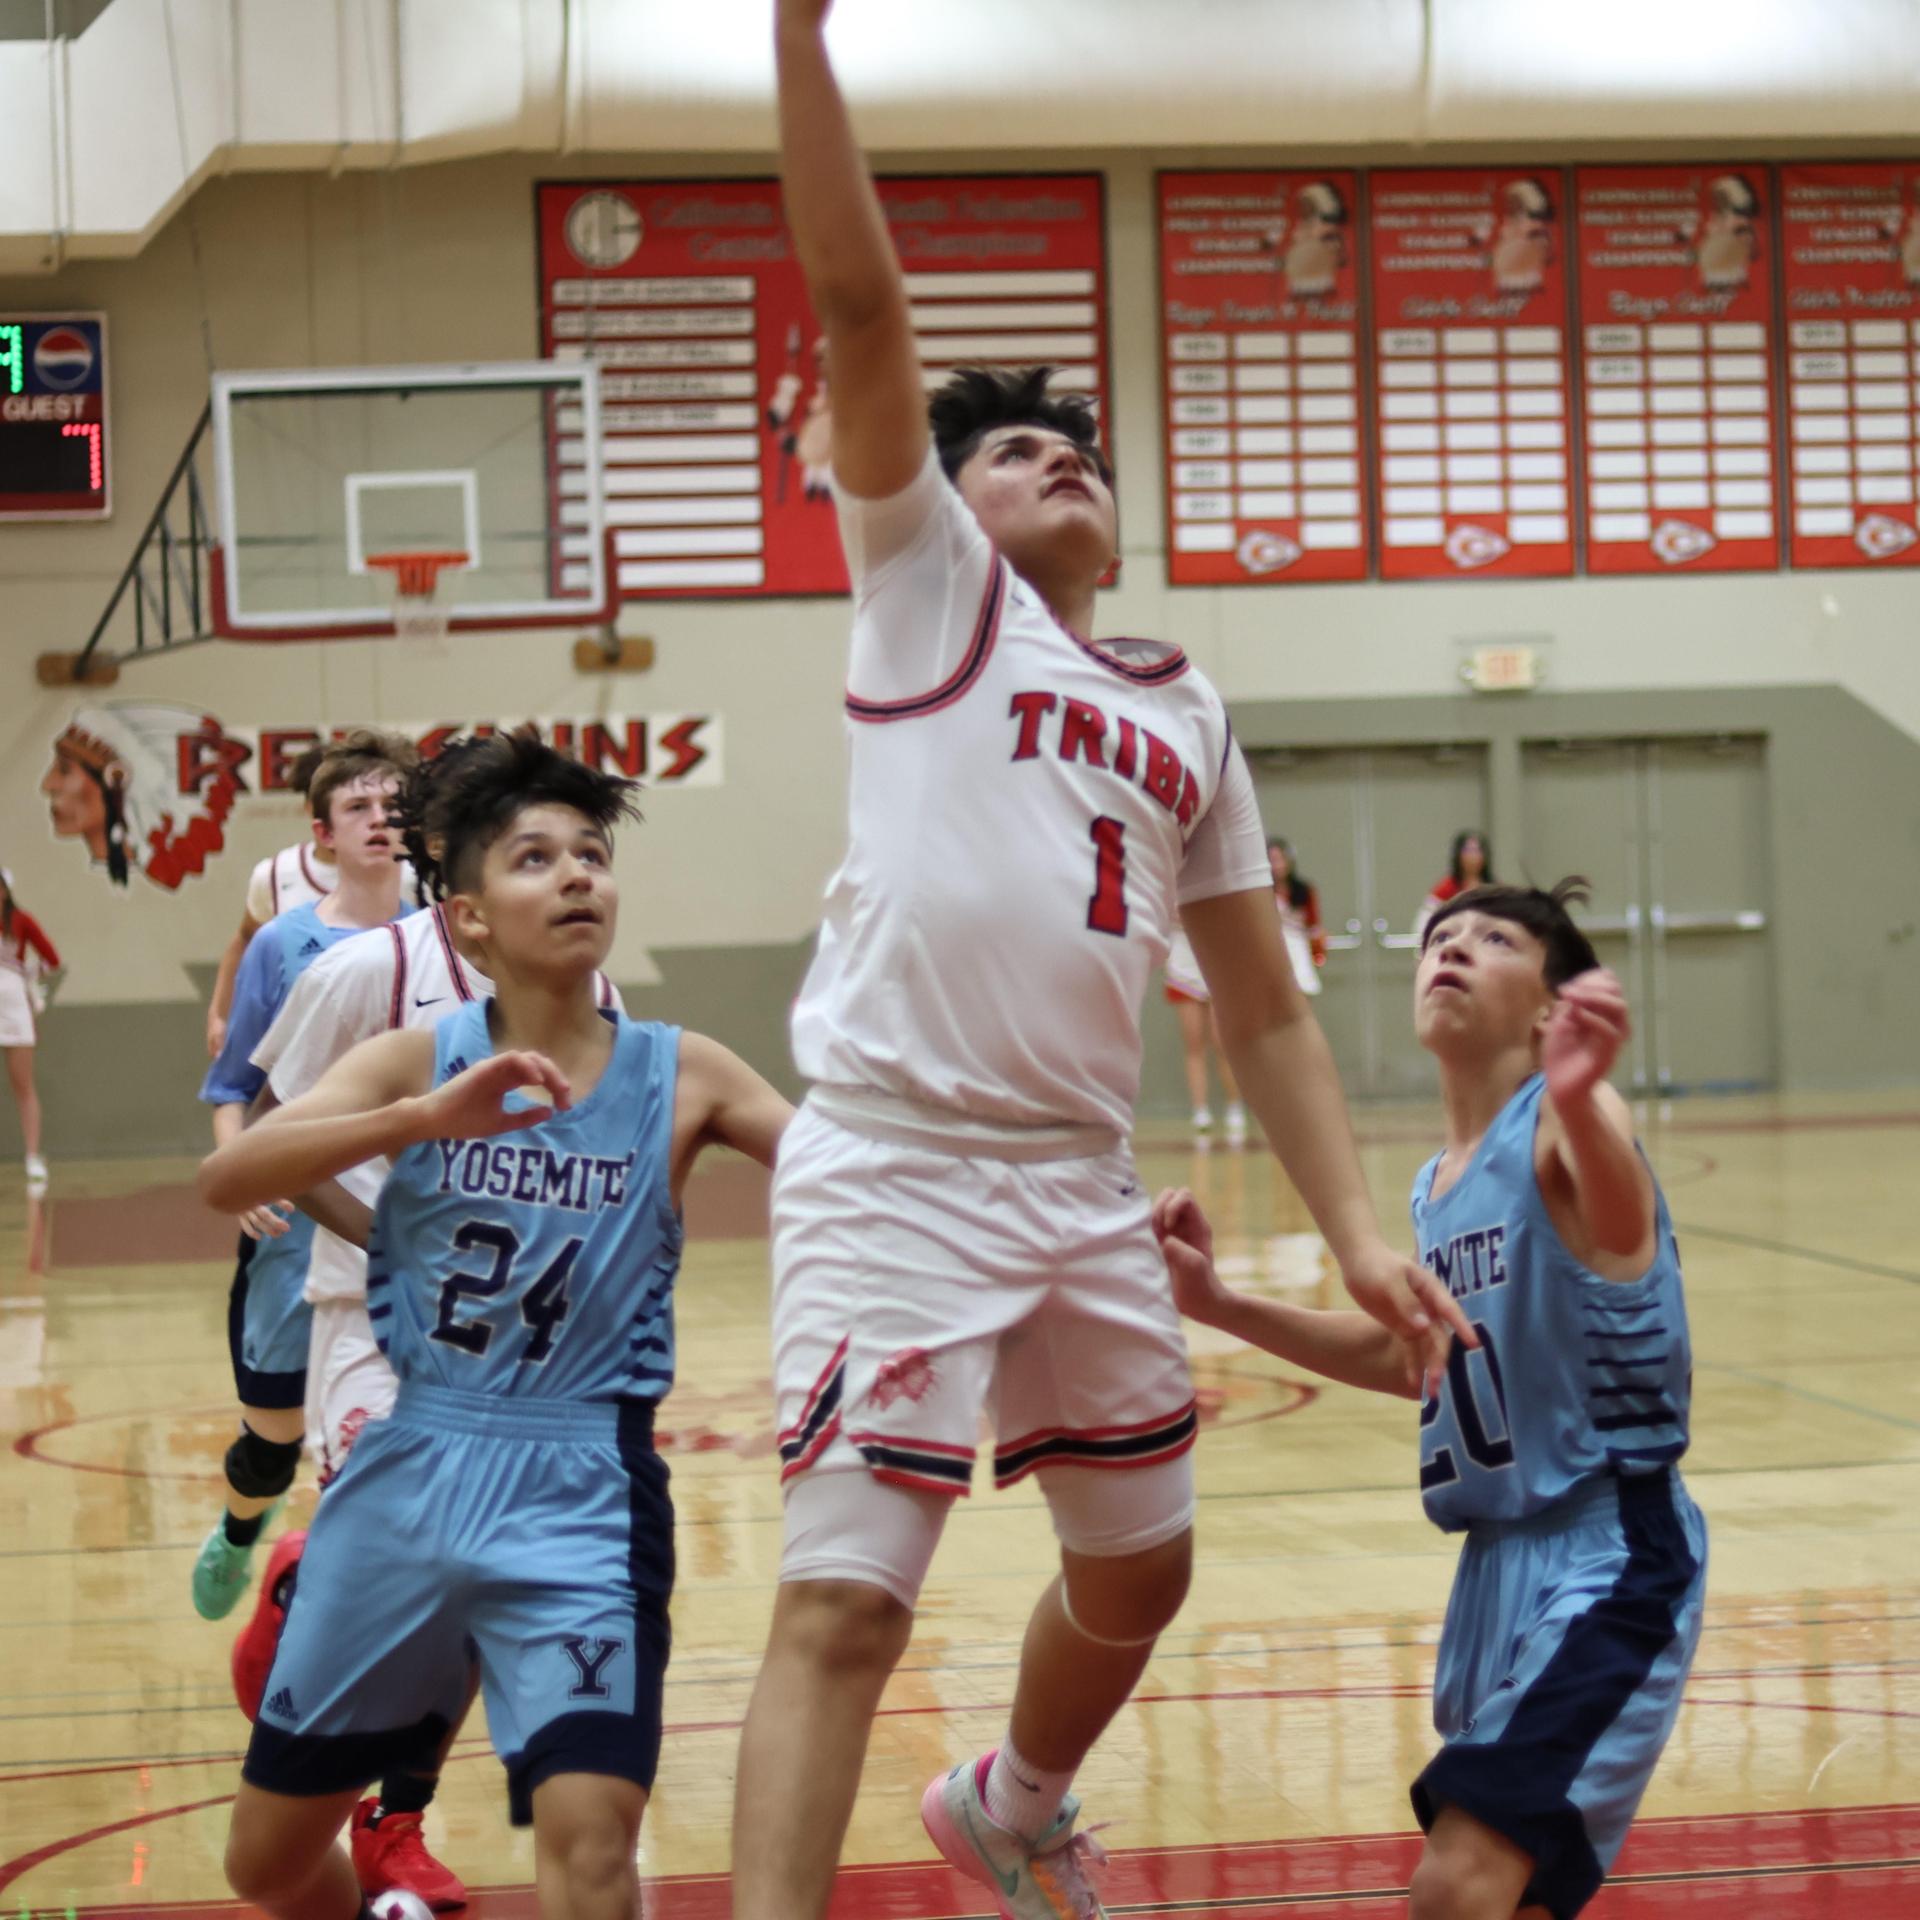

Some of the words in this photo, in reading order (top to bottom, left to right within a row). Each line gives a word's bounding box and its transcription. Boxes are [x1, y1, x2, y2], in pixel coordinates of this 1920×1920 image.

[3, 394, 87, 421] GUEST
[61, 423, 102, 490] 7
[1087, 815, 1128, 938] 1
[429, 1219, 585, 1362] 24
[1425, 1225, 1506, 1298] MITE
[562, 1637, 625, 1697] Y
